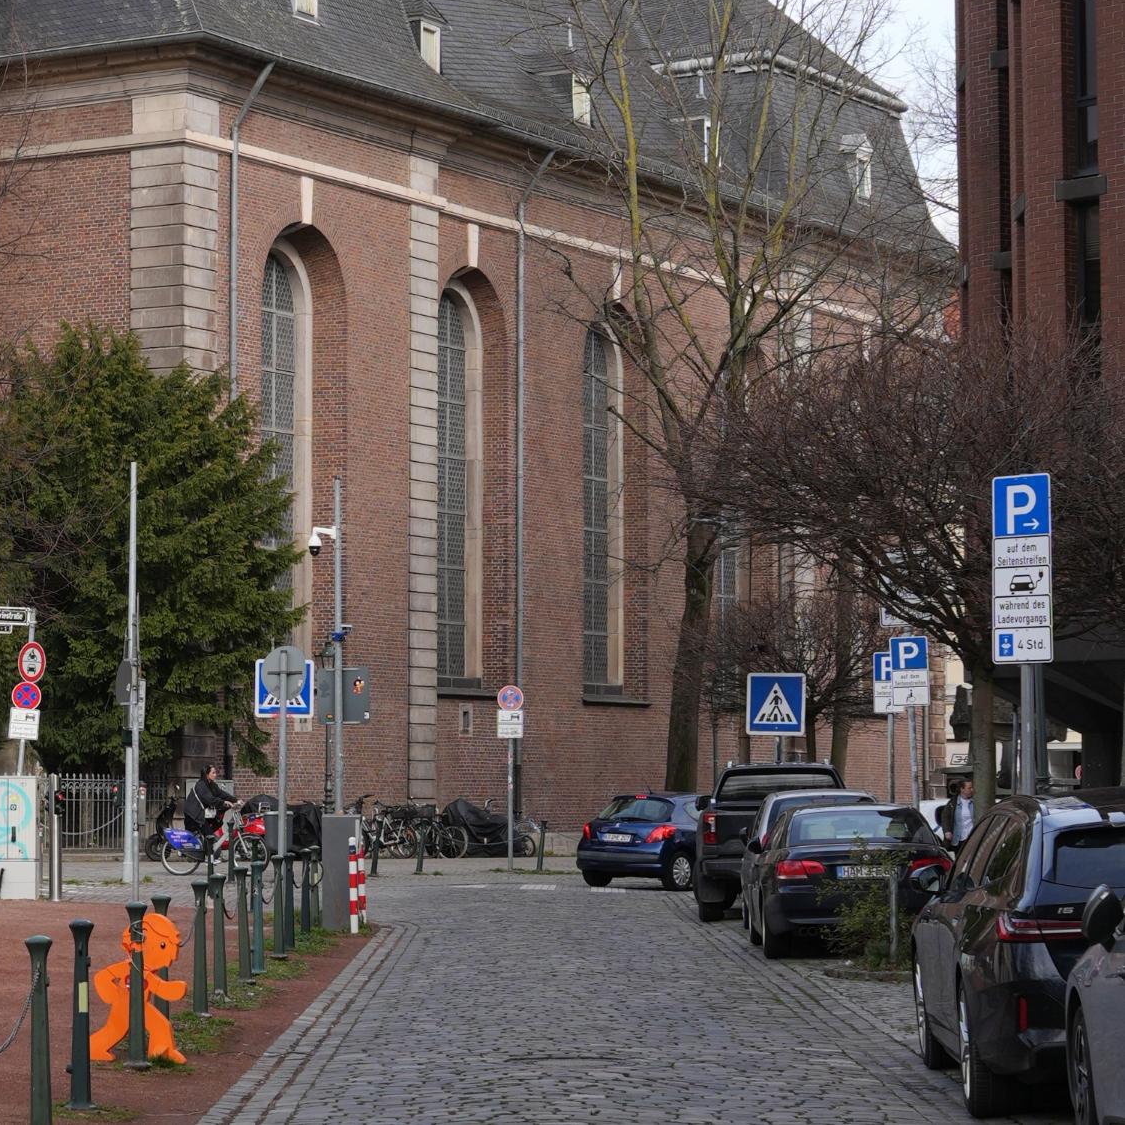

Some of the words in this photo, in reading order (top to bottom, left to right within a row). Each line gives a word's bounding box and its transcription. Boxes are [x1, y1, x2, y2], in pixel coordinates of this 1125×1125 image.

[1006, 484, 1037, 535] P
[1006, 544, 1018, 554] auf
[1021, 543, 1037, 552] dem
[997, 555, 1047, 566] Seitenstreifen
[999, 600, 1030, 610] während
[1032, 600, 1045, 609] des
[997, 614, 1047, 625] Ladevorgangs
[1017, 639, 1024, 650] 4
[1026, 639, 1047, 650] Std.
[898, 641, 919, 669] P
